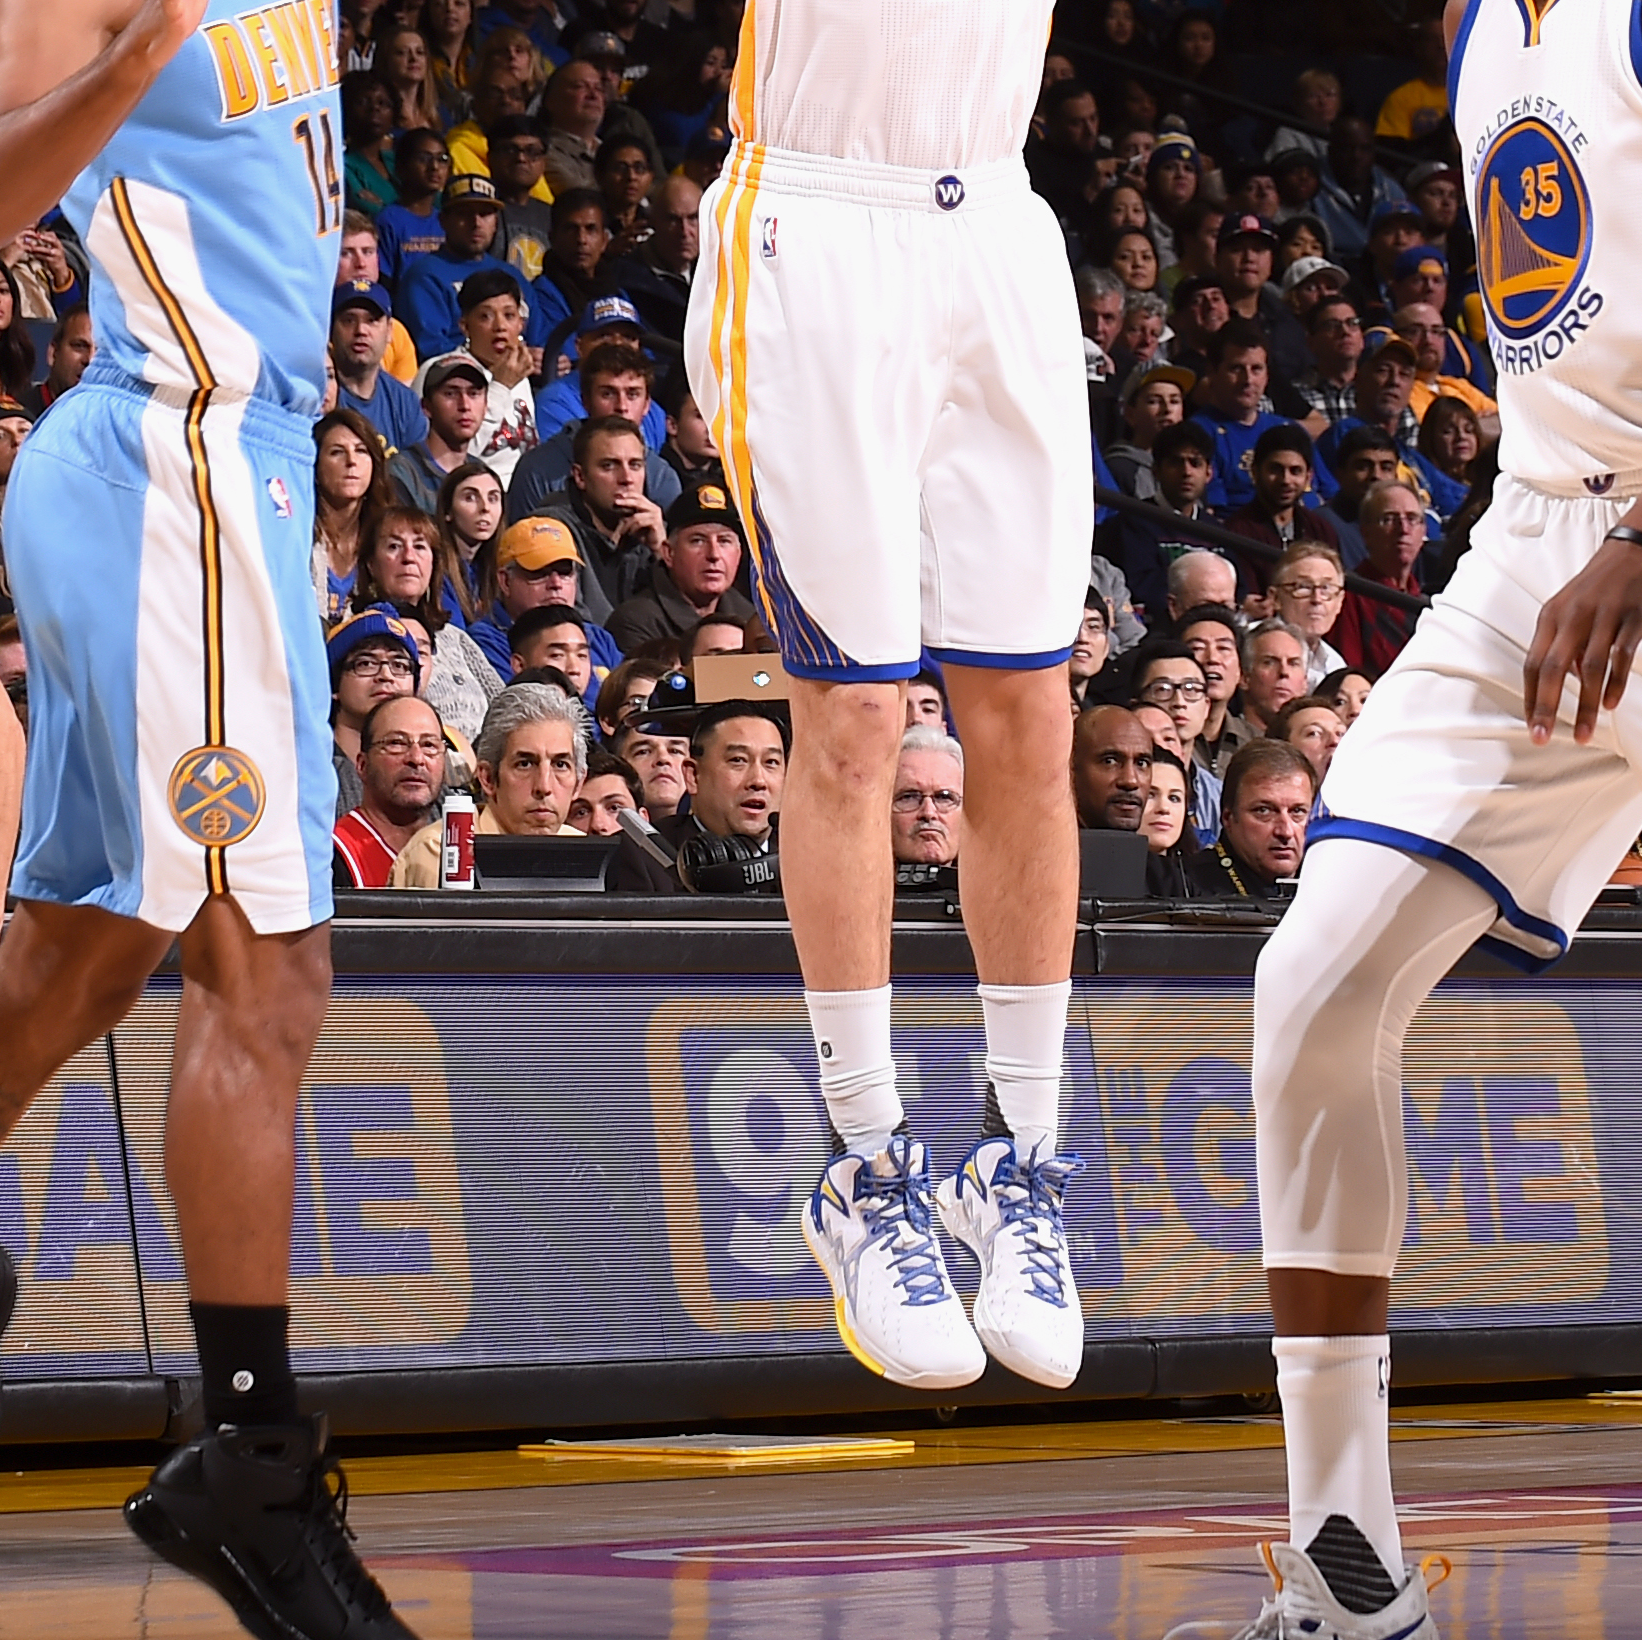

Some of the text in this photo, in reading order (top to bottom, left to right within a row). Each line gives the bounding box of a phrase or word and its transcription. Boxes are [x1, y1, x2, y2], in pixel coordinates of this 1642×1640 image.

[1469, 94, 1589, 176] GOLDEN STATE
[1519, 160, 1563, 222] 35
[744, 860, 775, 885] JBL
[1156, 1054, 1578, 1251] GME
